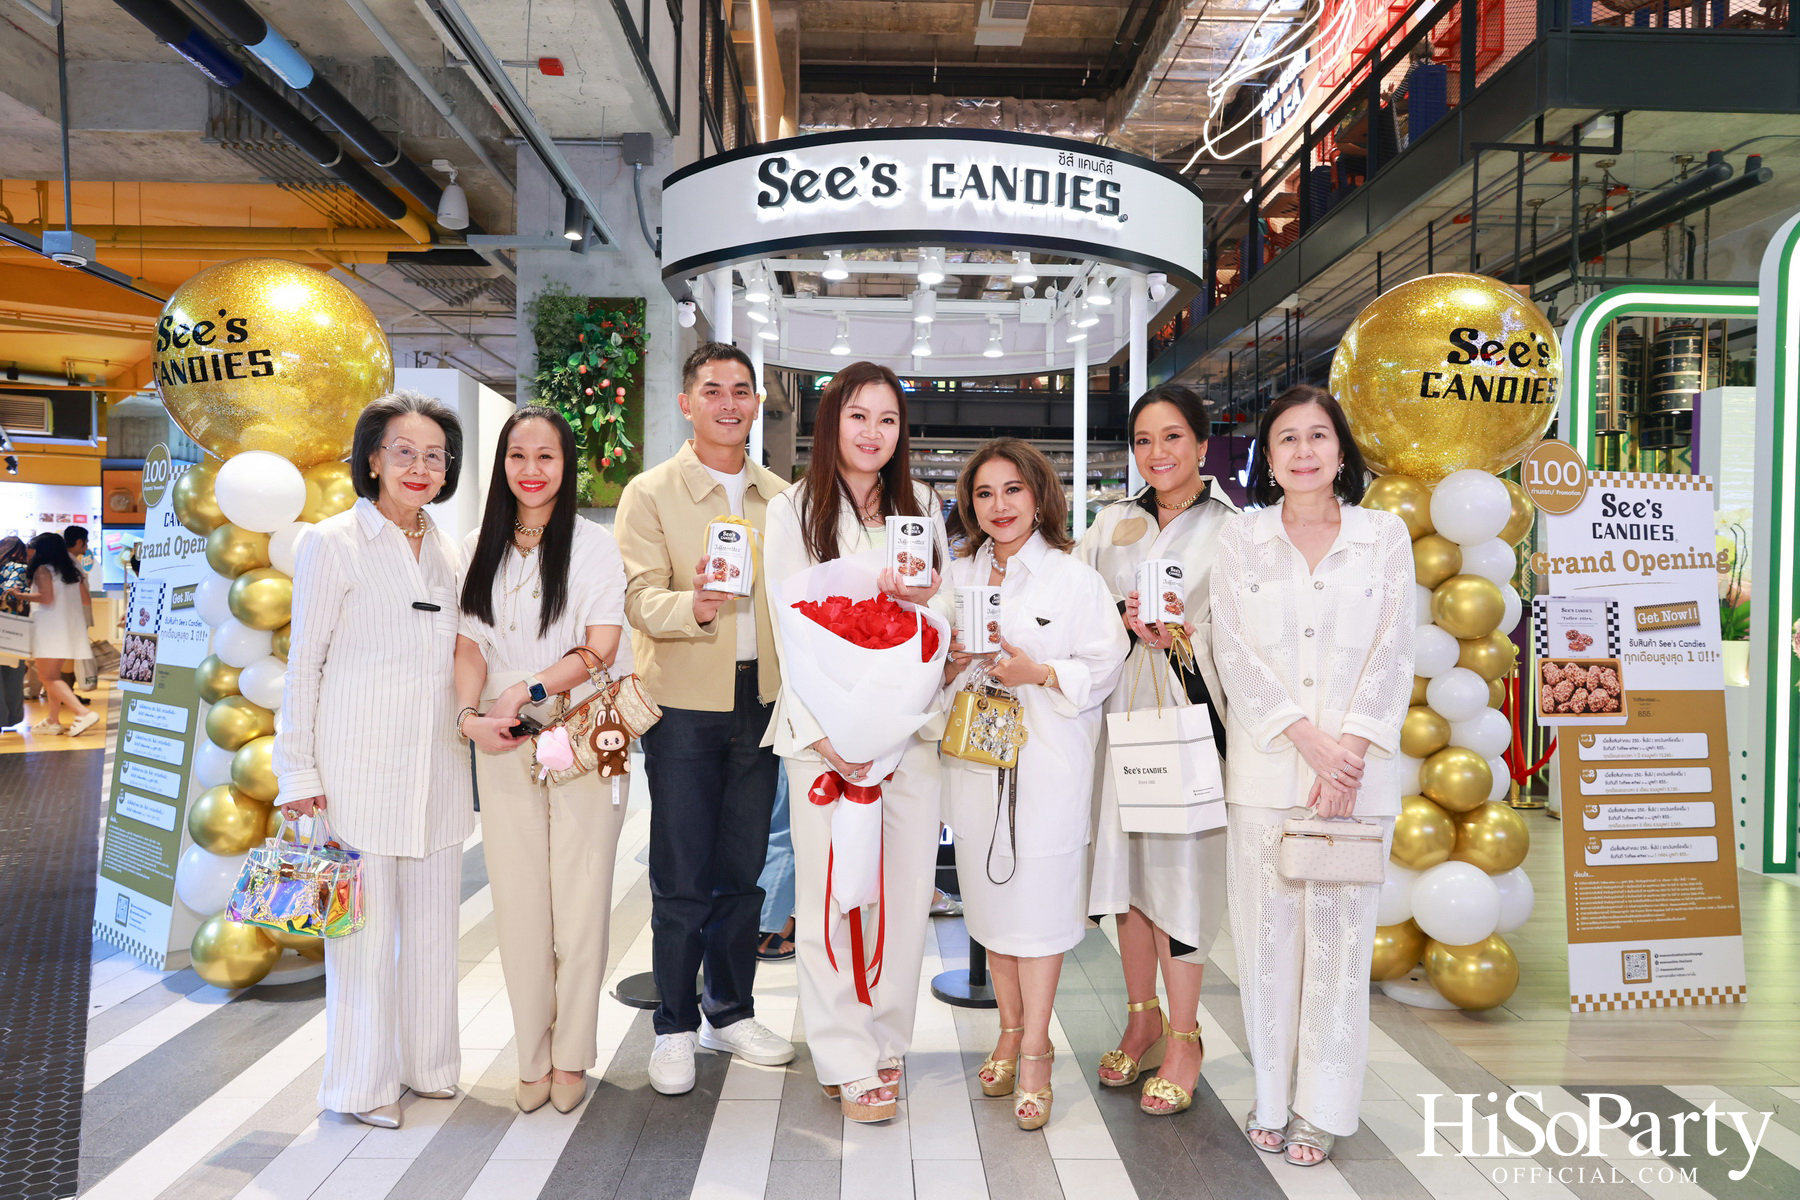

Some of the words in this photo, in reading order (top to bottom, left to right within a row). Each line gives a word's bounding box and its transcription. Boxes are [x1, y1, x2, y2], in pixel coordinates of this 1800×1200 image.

[757, 156, 898, 208] See's
[931, 162, 1121, 217] CANDIES
[157, 308, 248, 353] See's
[1447, 327, 1550, 368] See's
[152, 349, 274, 387] CANDIES
[1420, 371, 1559, 405] CANDIES
[144, 459, 167, 483] 100
[1529, 460, 1581, 487] 100
[1555, 488, 1582, 496] Promotion
[1601, 493, 1663, 519] See's
[1592, 522, 1674, 541] CANDIES
[1530, 551, 1616, 576] Grand
[1622, 546, 1731, 576] Opening
[1637, 612, 1660, 625] Get
[1660, 607, 1698, 623] Now!!
[1658, 640, 1677, 648] See's
[1678, 639, 1706, 648] Candies
[1687, 651, 1695, 662] 1
[1123, 766, 1141, 775] See's
